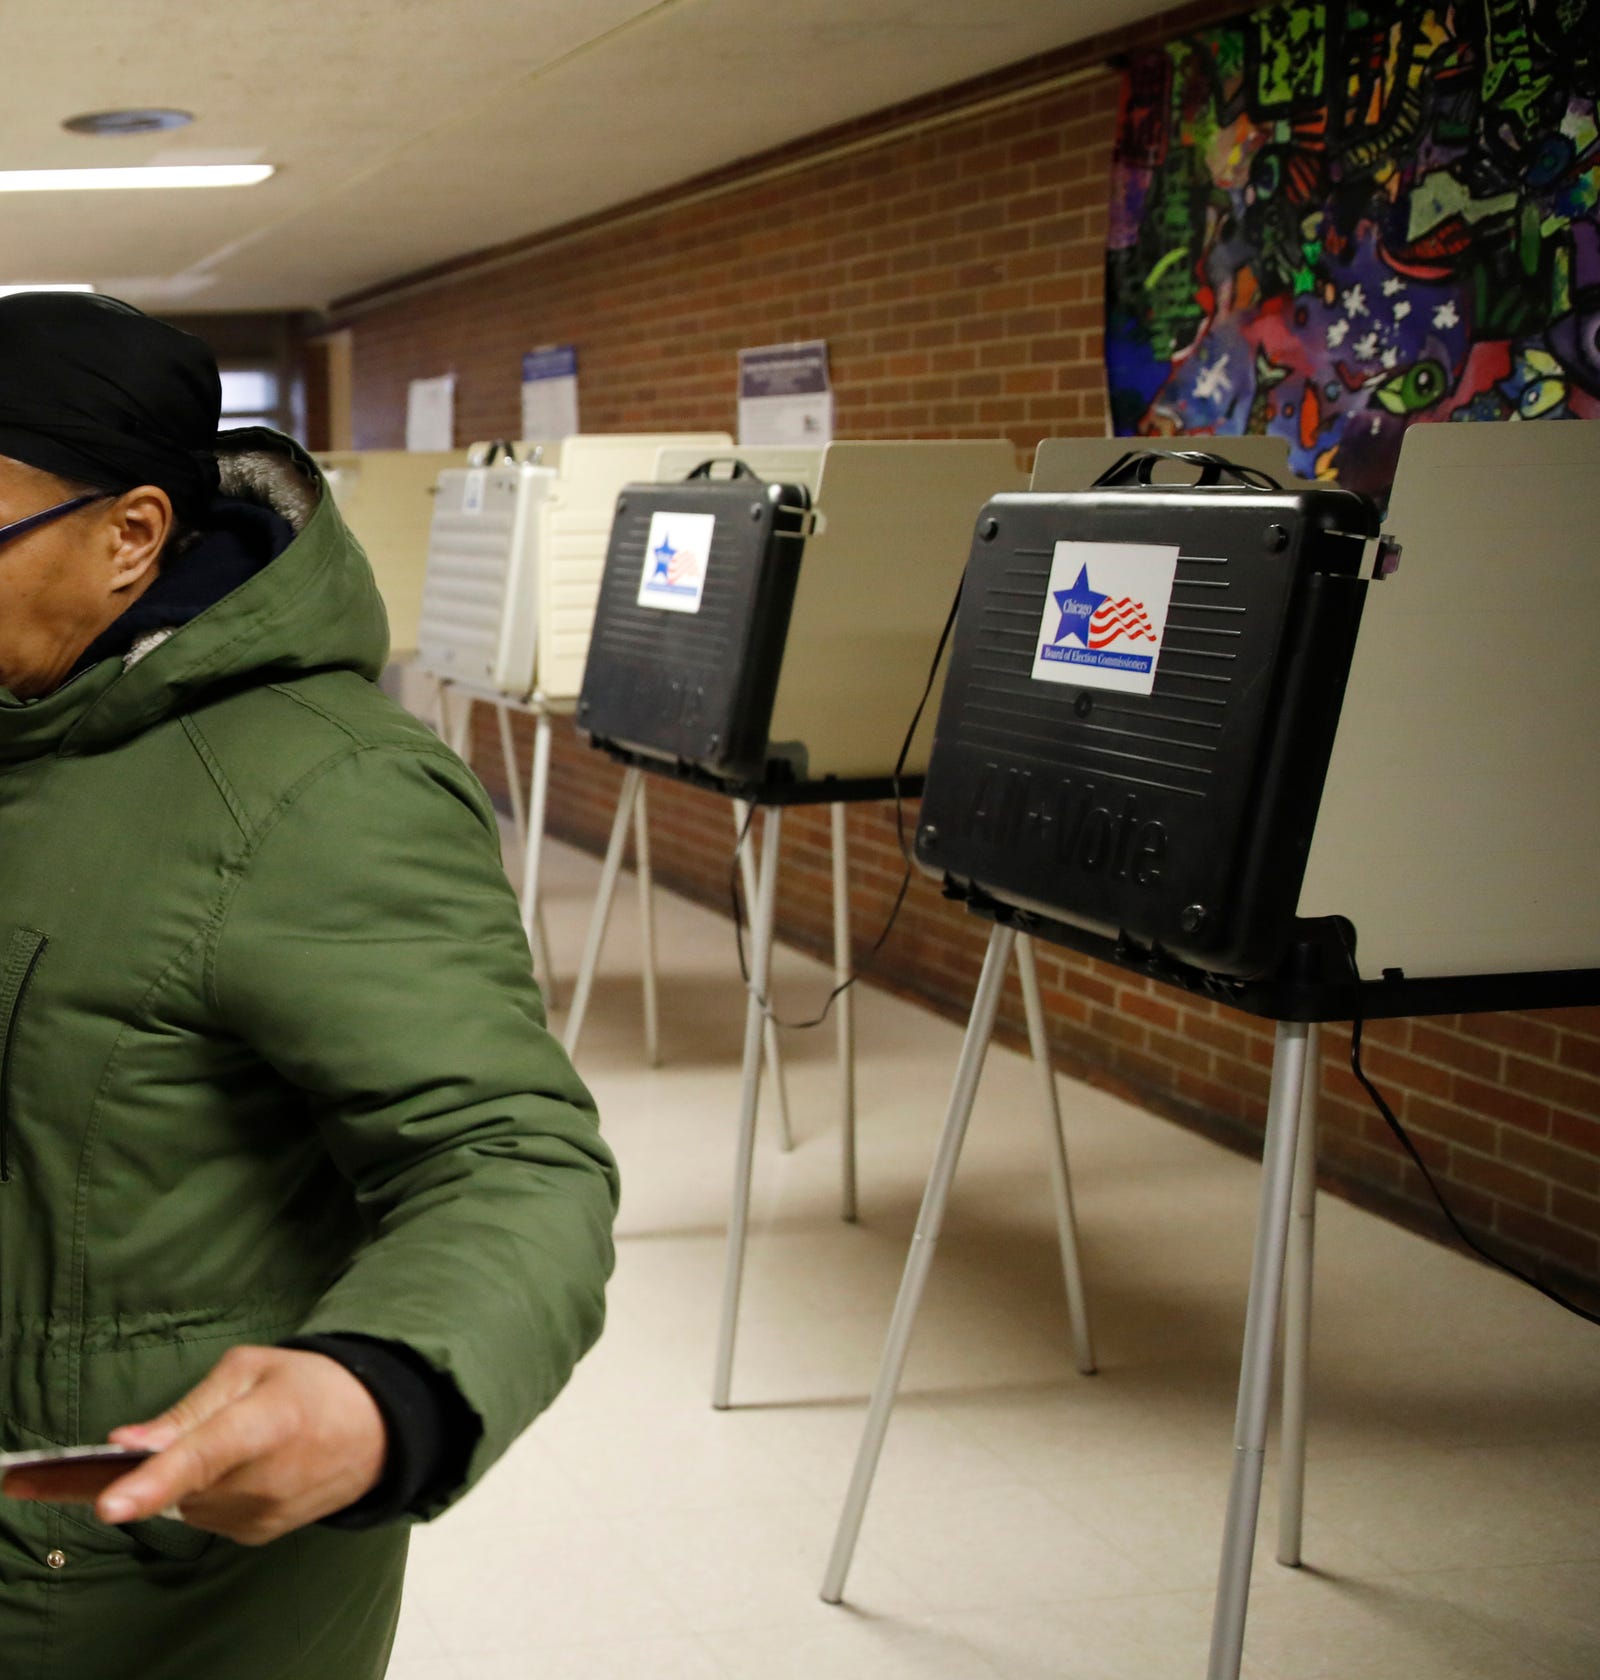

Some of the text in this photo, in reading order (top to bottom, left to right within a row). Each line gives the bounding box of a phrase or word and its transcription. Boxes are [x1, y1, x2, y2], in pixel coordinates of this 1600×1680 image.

[1063, 598, 1093, 619] Chicago
[1044, 646, 1148, 671] Board of Election Commissioners
